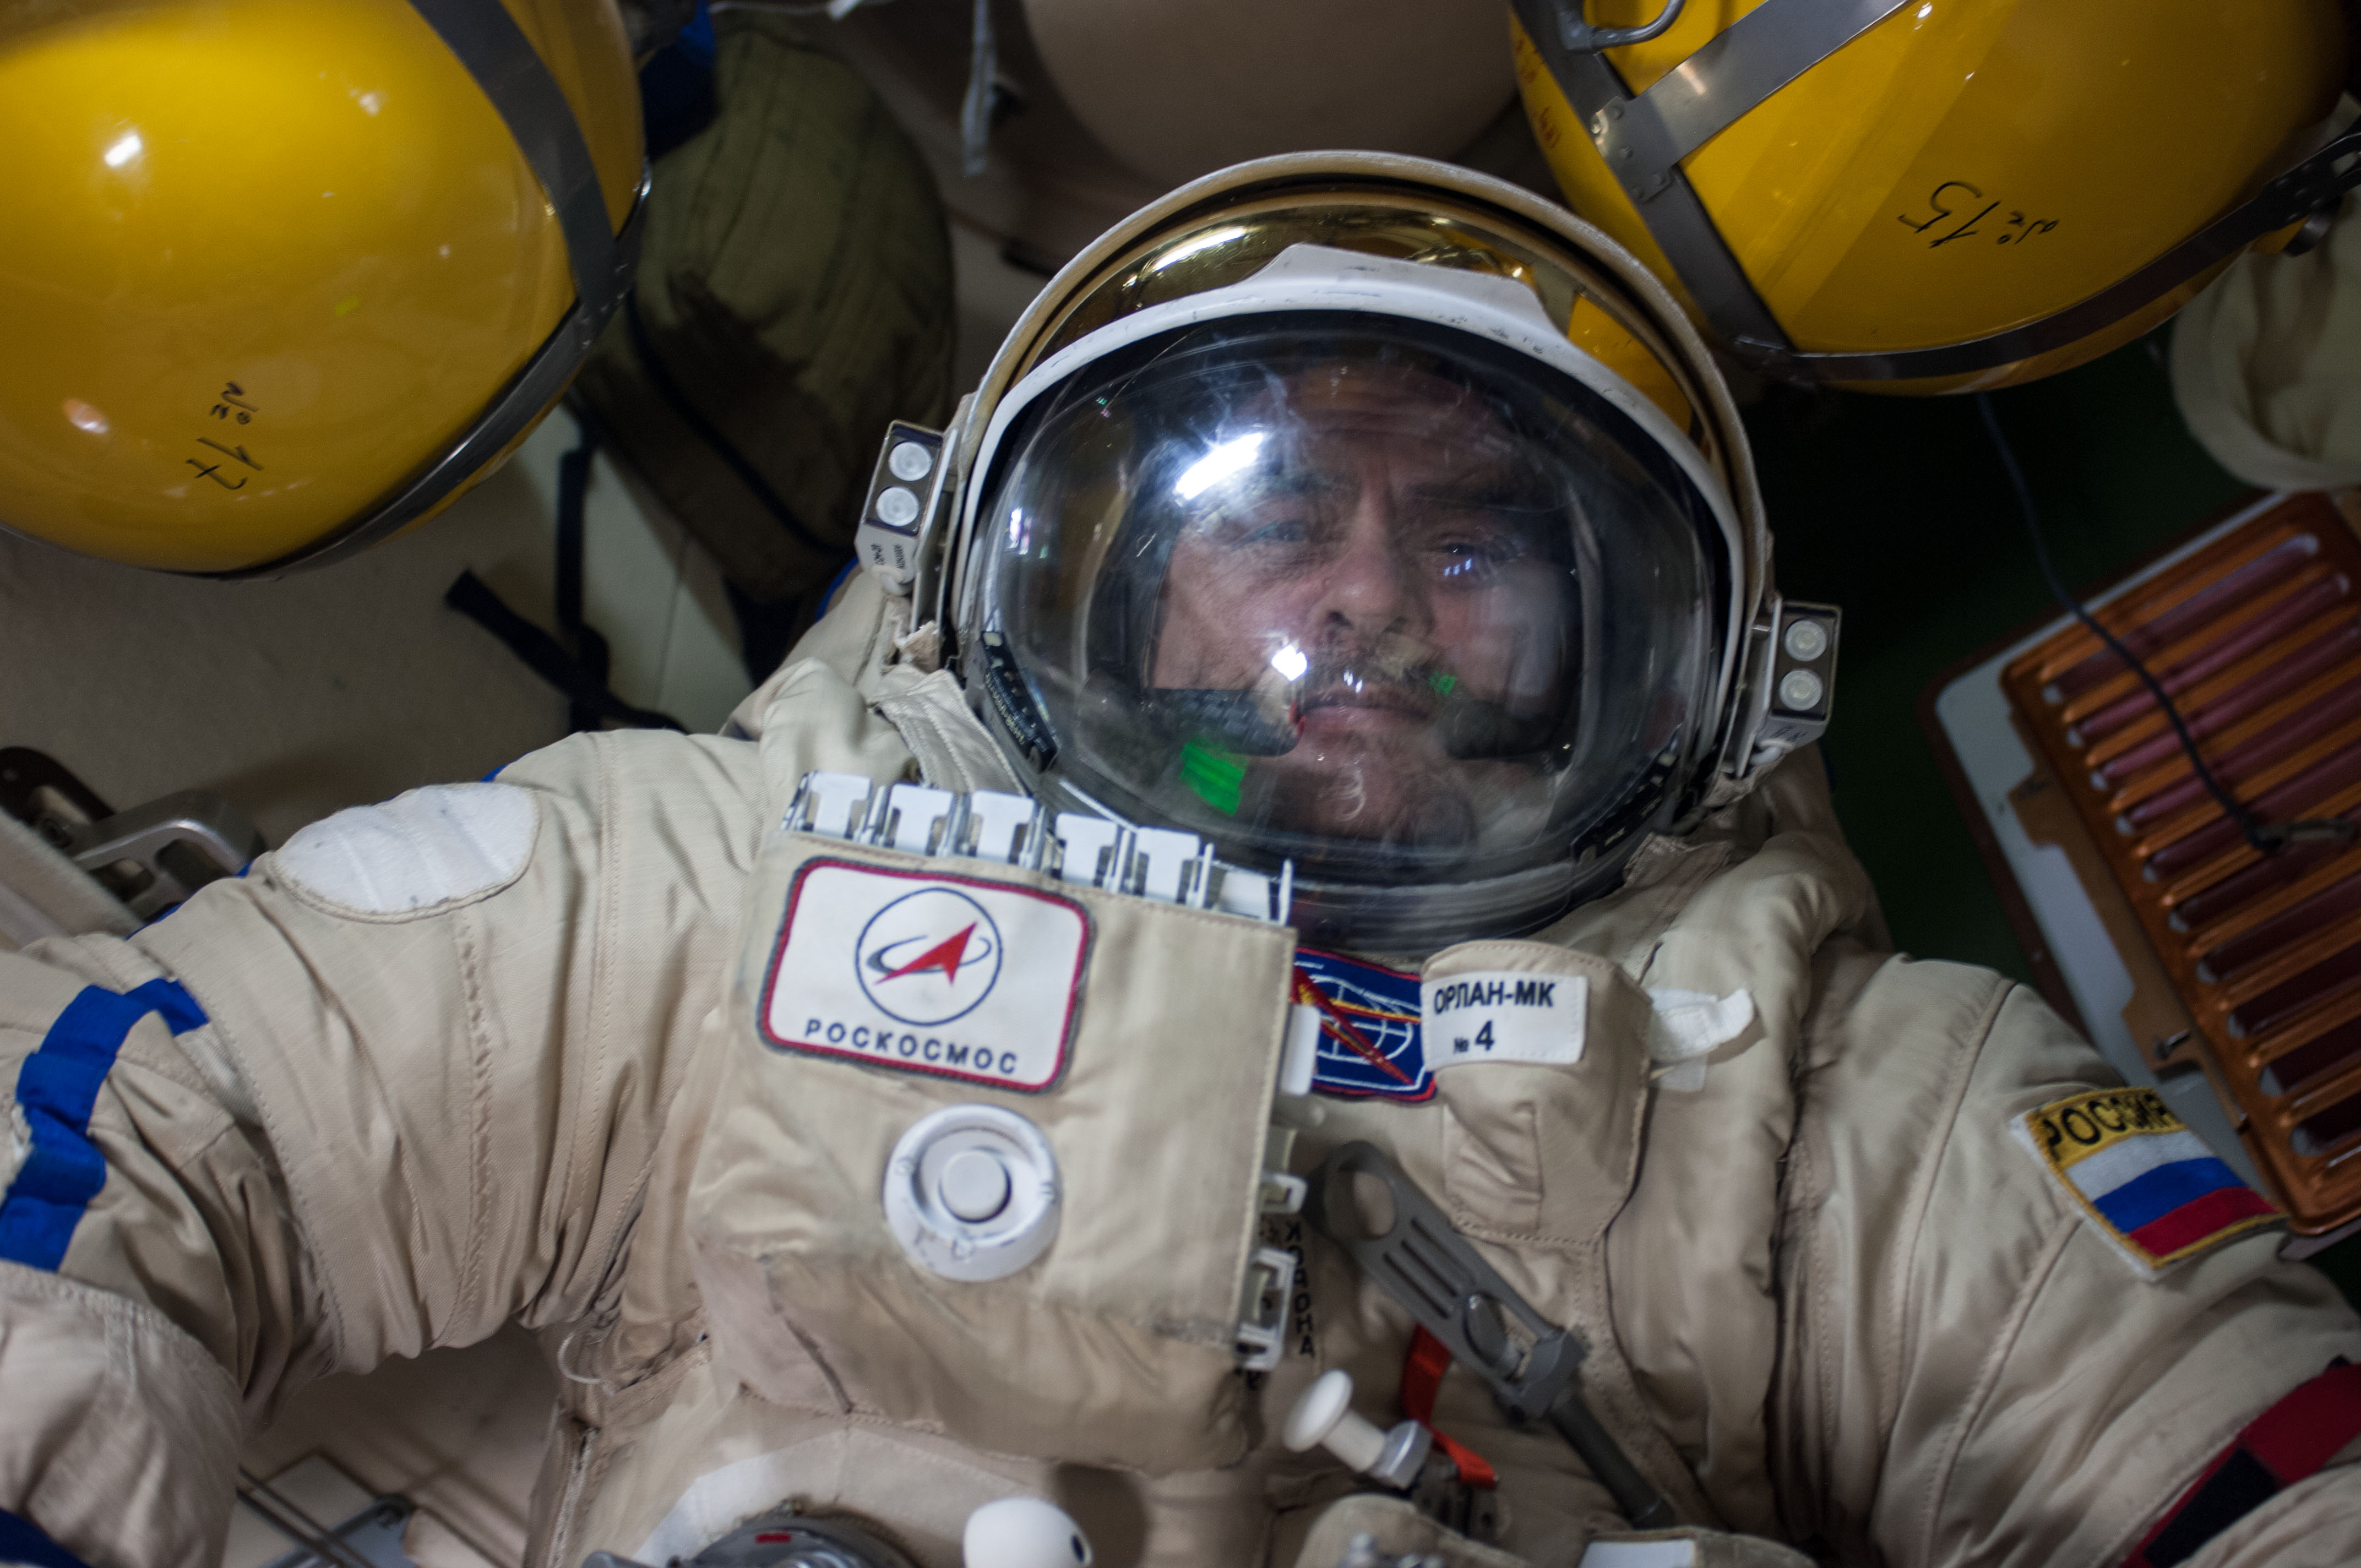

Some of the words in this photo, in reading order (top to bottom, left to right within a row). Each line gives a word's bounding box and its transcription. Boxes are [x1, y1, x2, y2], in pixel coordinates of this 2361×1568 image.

[1434, 979, 1555, 1015] ОРЛАН-МК
[804, 1019, 1018, 1074] РОСКОСМОС
[1475, 1020, 1495, 1052] 4
